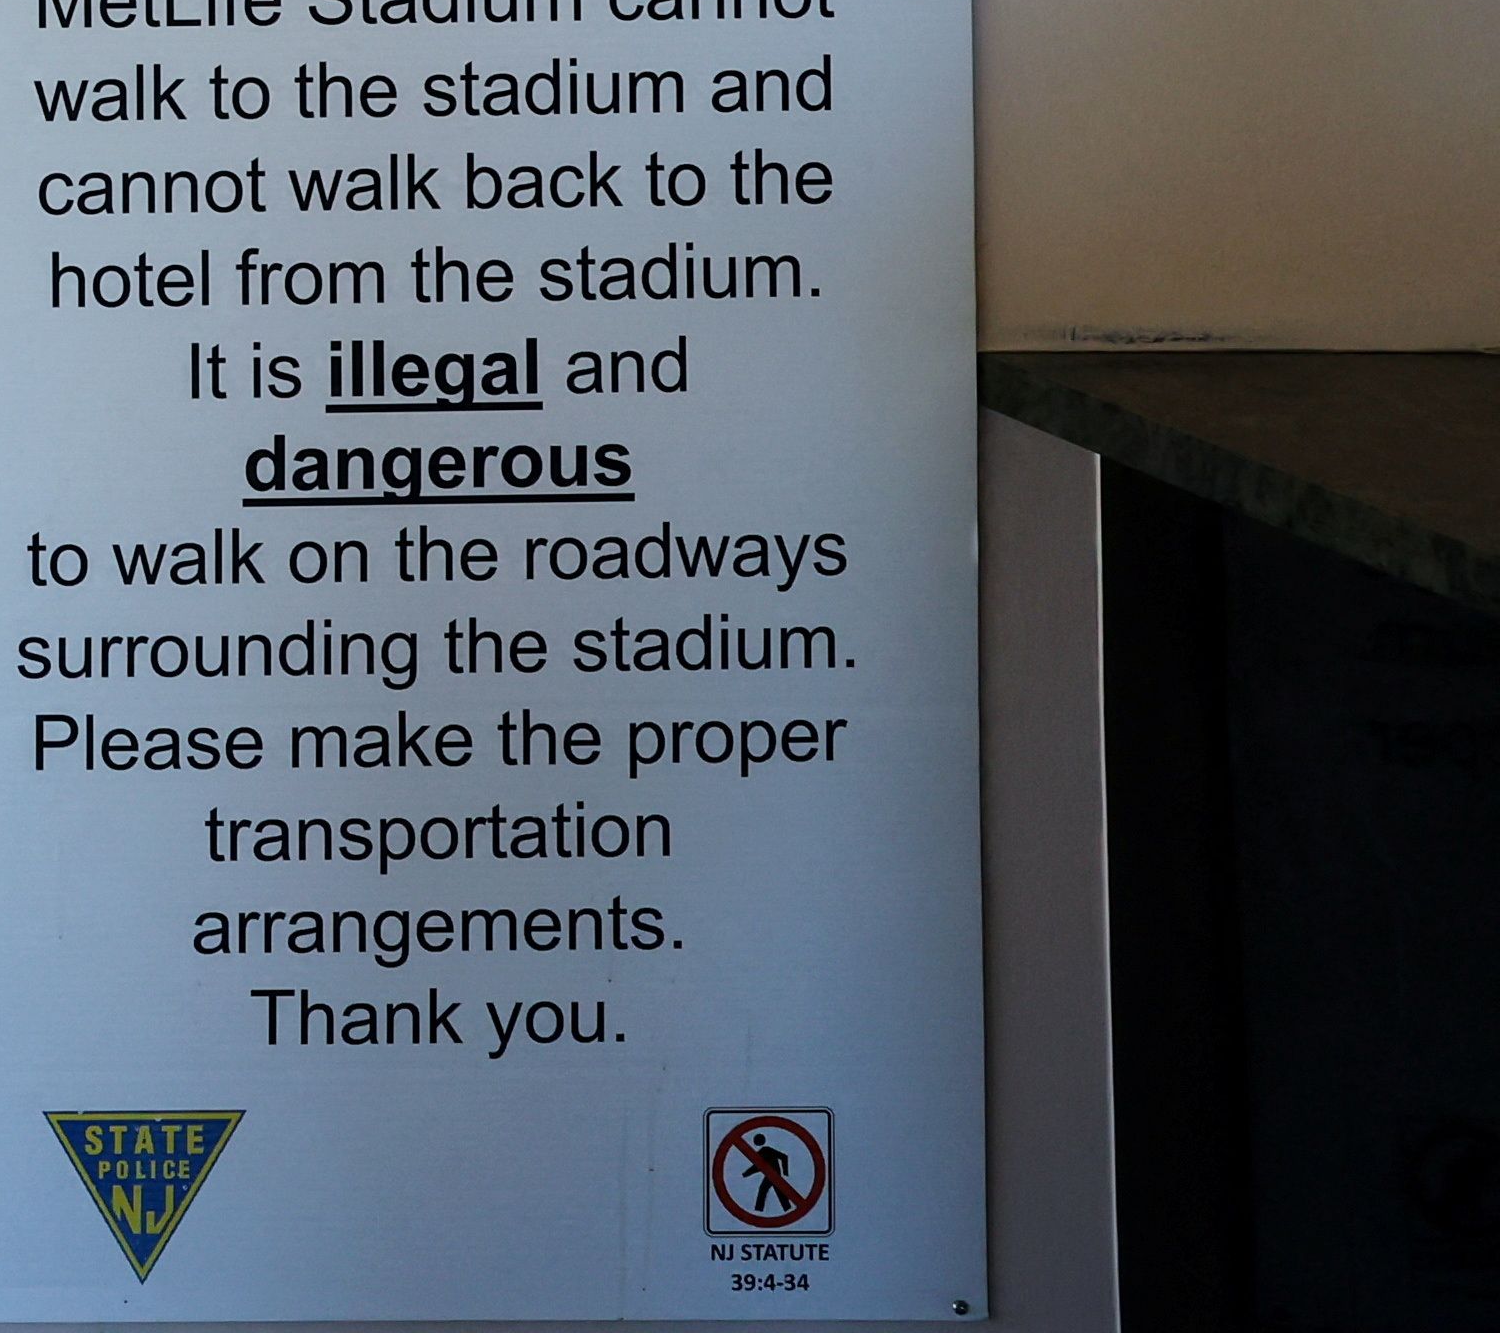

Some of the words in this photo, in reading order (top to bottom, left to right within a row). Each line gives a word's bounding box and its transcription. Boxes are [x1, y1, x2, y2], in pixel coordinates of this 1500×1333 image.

[33, 63, 188, 122] walk
[208, 64, 271, 120] to
[293, 60, 398, 119] the
[423, 57, 684, 118] stadium
[711, 53, 832, 114] and
[38, 156, 267, 216] cannot
[287, 152, 442, 212] walk
[466, 150, 624, 210] back
[644, 151, 706, 207] to
[729, 147, 833, 206] the
[51, 249, 210, 309] hotel
[235, 247, 385, 306] from
[410, 245, 514, 304] the
[539, 241, 821, 302] stadium.
[190, 342, 228, 400] It
[252, 341, 302, 399] is
[324, 337, 544, 409] illegal
[566, 334, 688, 395] and
[241, 434, 636, 503] dangerous
[26, 531, 89, 587] to
[111, 527, 266, 586] walk
[289, 539, 368, 584] on
[394, 524, 498, 583] the
[526, 521, 847, 593] roadways
[17, 618, 418, 691] surrounding
[443, 616, 548, 675] the
[573, 613, 855, 673] stadium.
[35, 713, 264, 771] Please
[291, 710, 473, 769] make
[496, 708, 602, 766] the
[629, 718, 848, 780] proper
[204, 800, 671, 876] transportation
[193, 894, 683, 969] arrangements.
[250, 987, 464, 1046] Thank
[485, 1000, 626, 1060] you.
[84, 1124, 205, 1156] STATE
[98, 1159, 191, 1179] POLICE
[112, 1184, 175, 1234] NJ
[710, 1243, 735, 1261] NJ
[740, 1243, 830, 1262] STATUTE
[731, 1273, 810, 1292] 39:4-34
